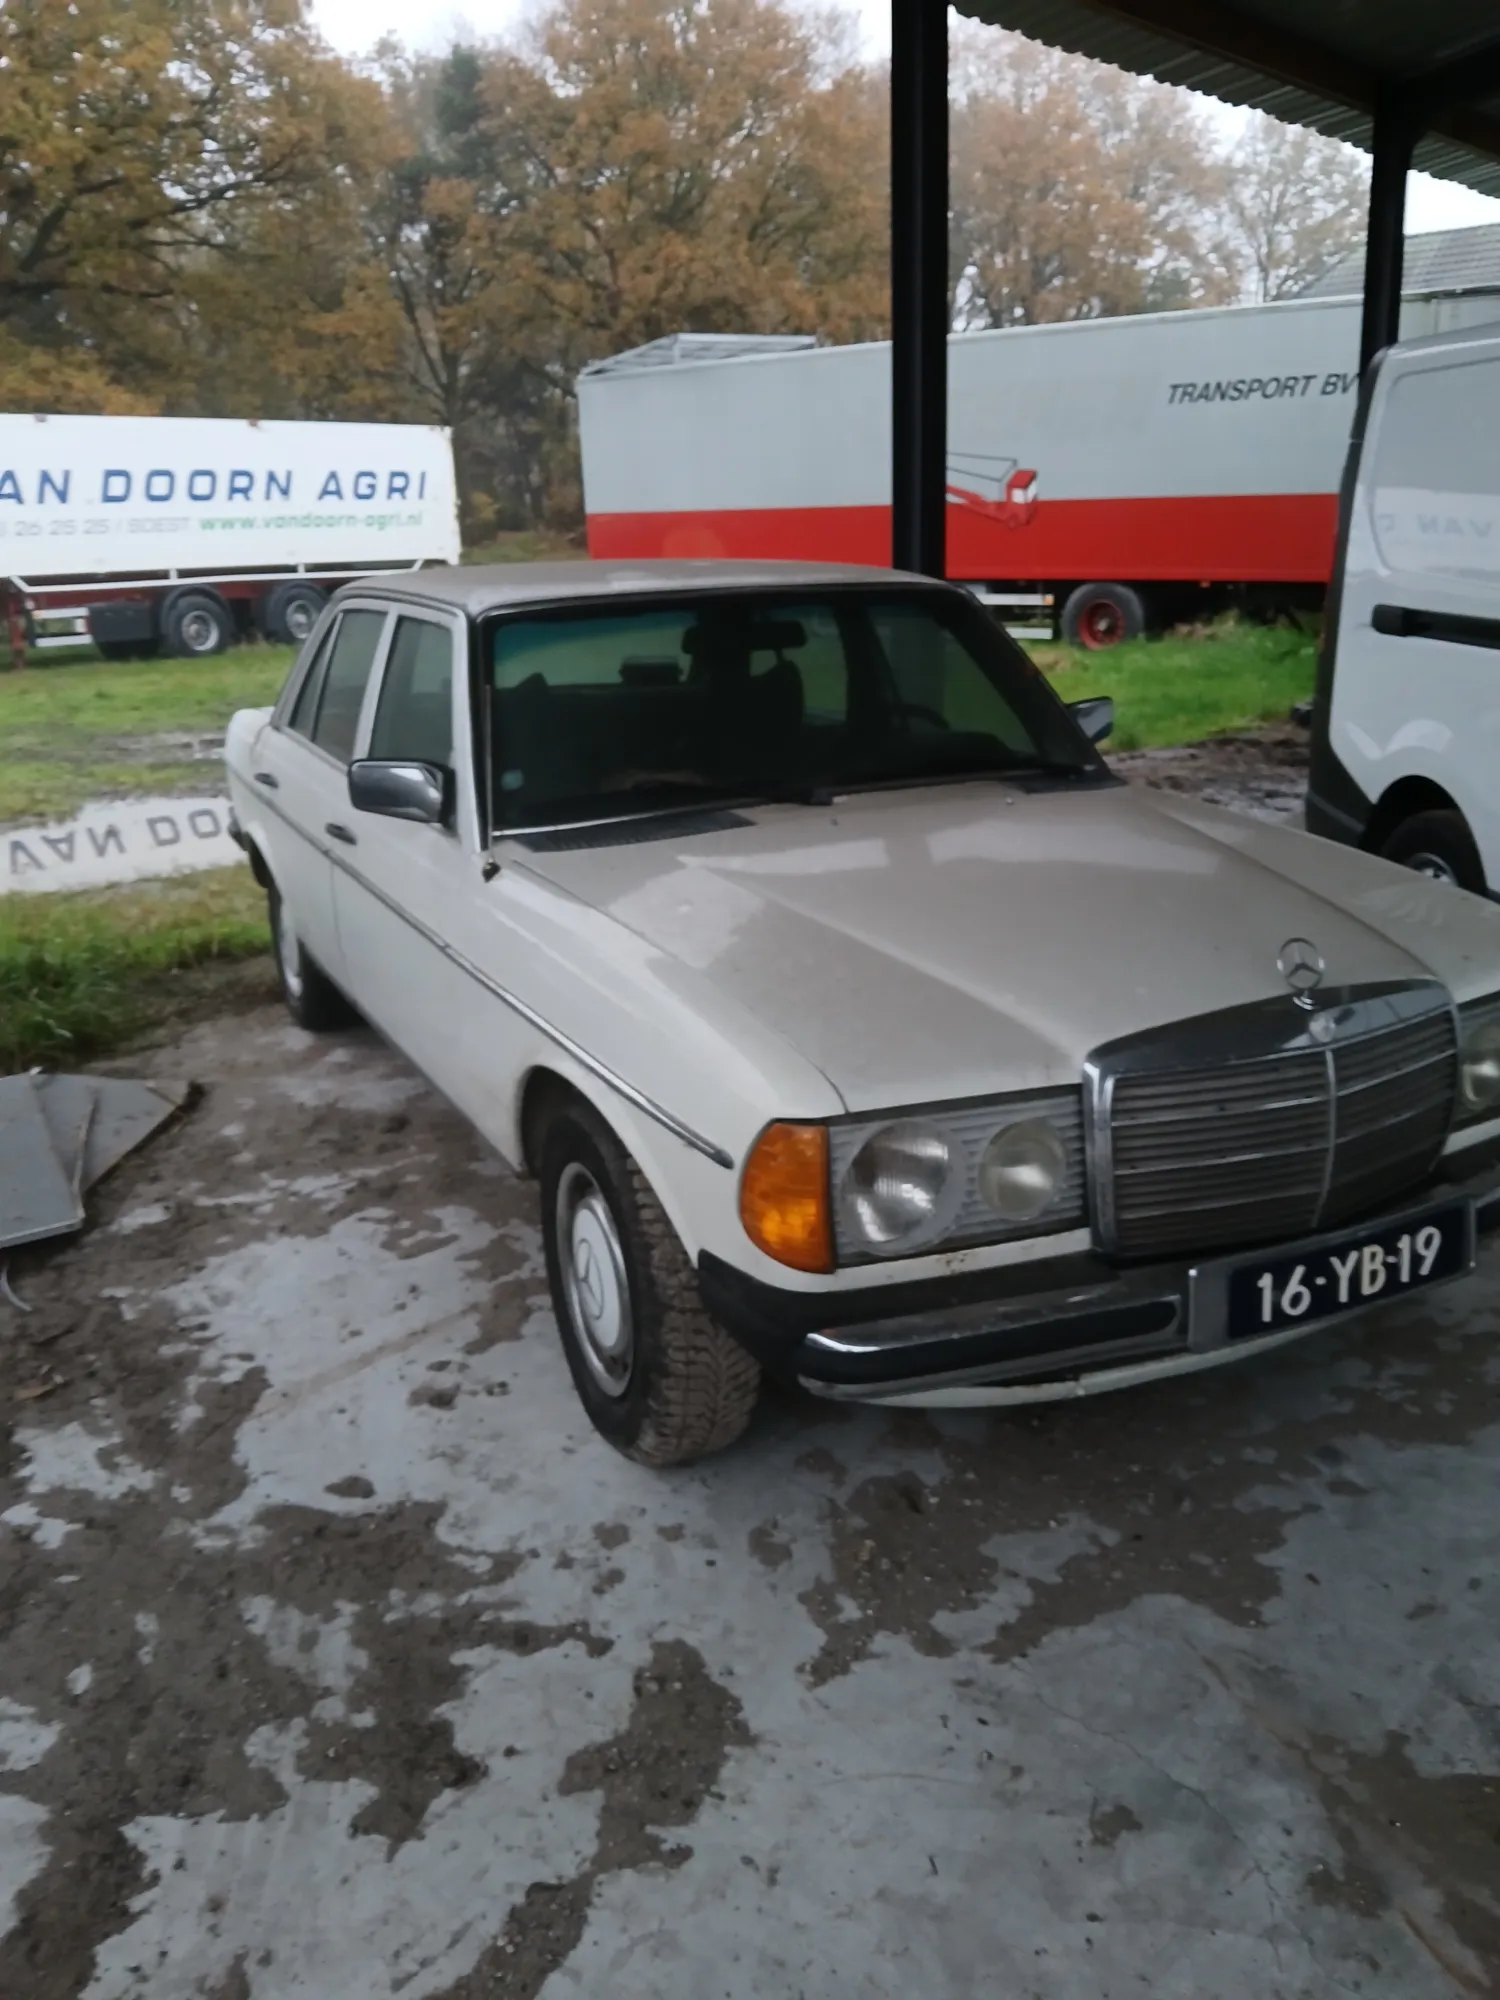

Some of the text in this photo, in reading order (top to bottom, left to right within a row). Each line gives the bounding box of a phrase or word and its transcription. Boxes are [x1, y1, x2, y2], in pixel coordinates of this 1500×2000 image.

[1168, 372, 1361, 404] TRANSPORT BV
[101, 469, 293, 503] DOORN
[317, 470, 428, 501] AGRI
[199, 512, 424, 532] www.vandoorn-agri.nl
[1256, 1225, 1442, 1323] 16-YB-19
